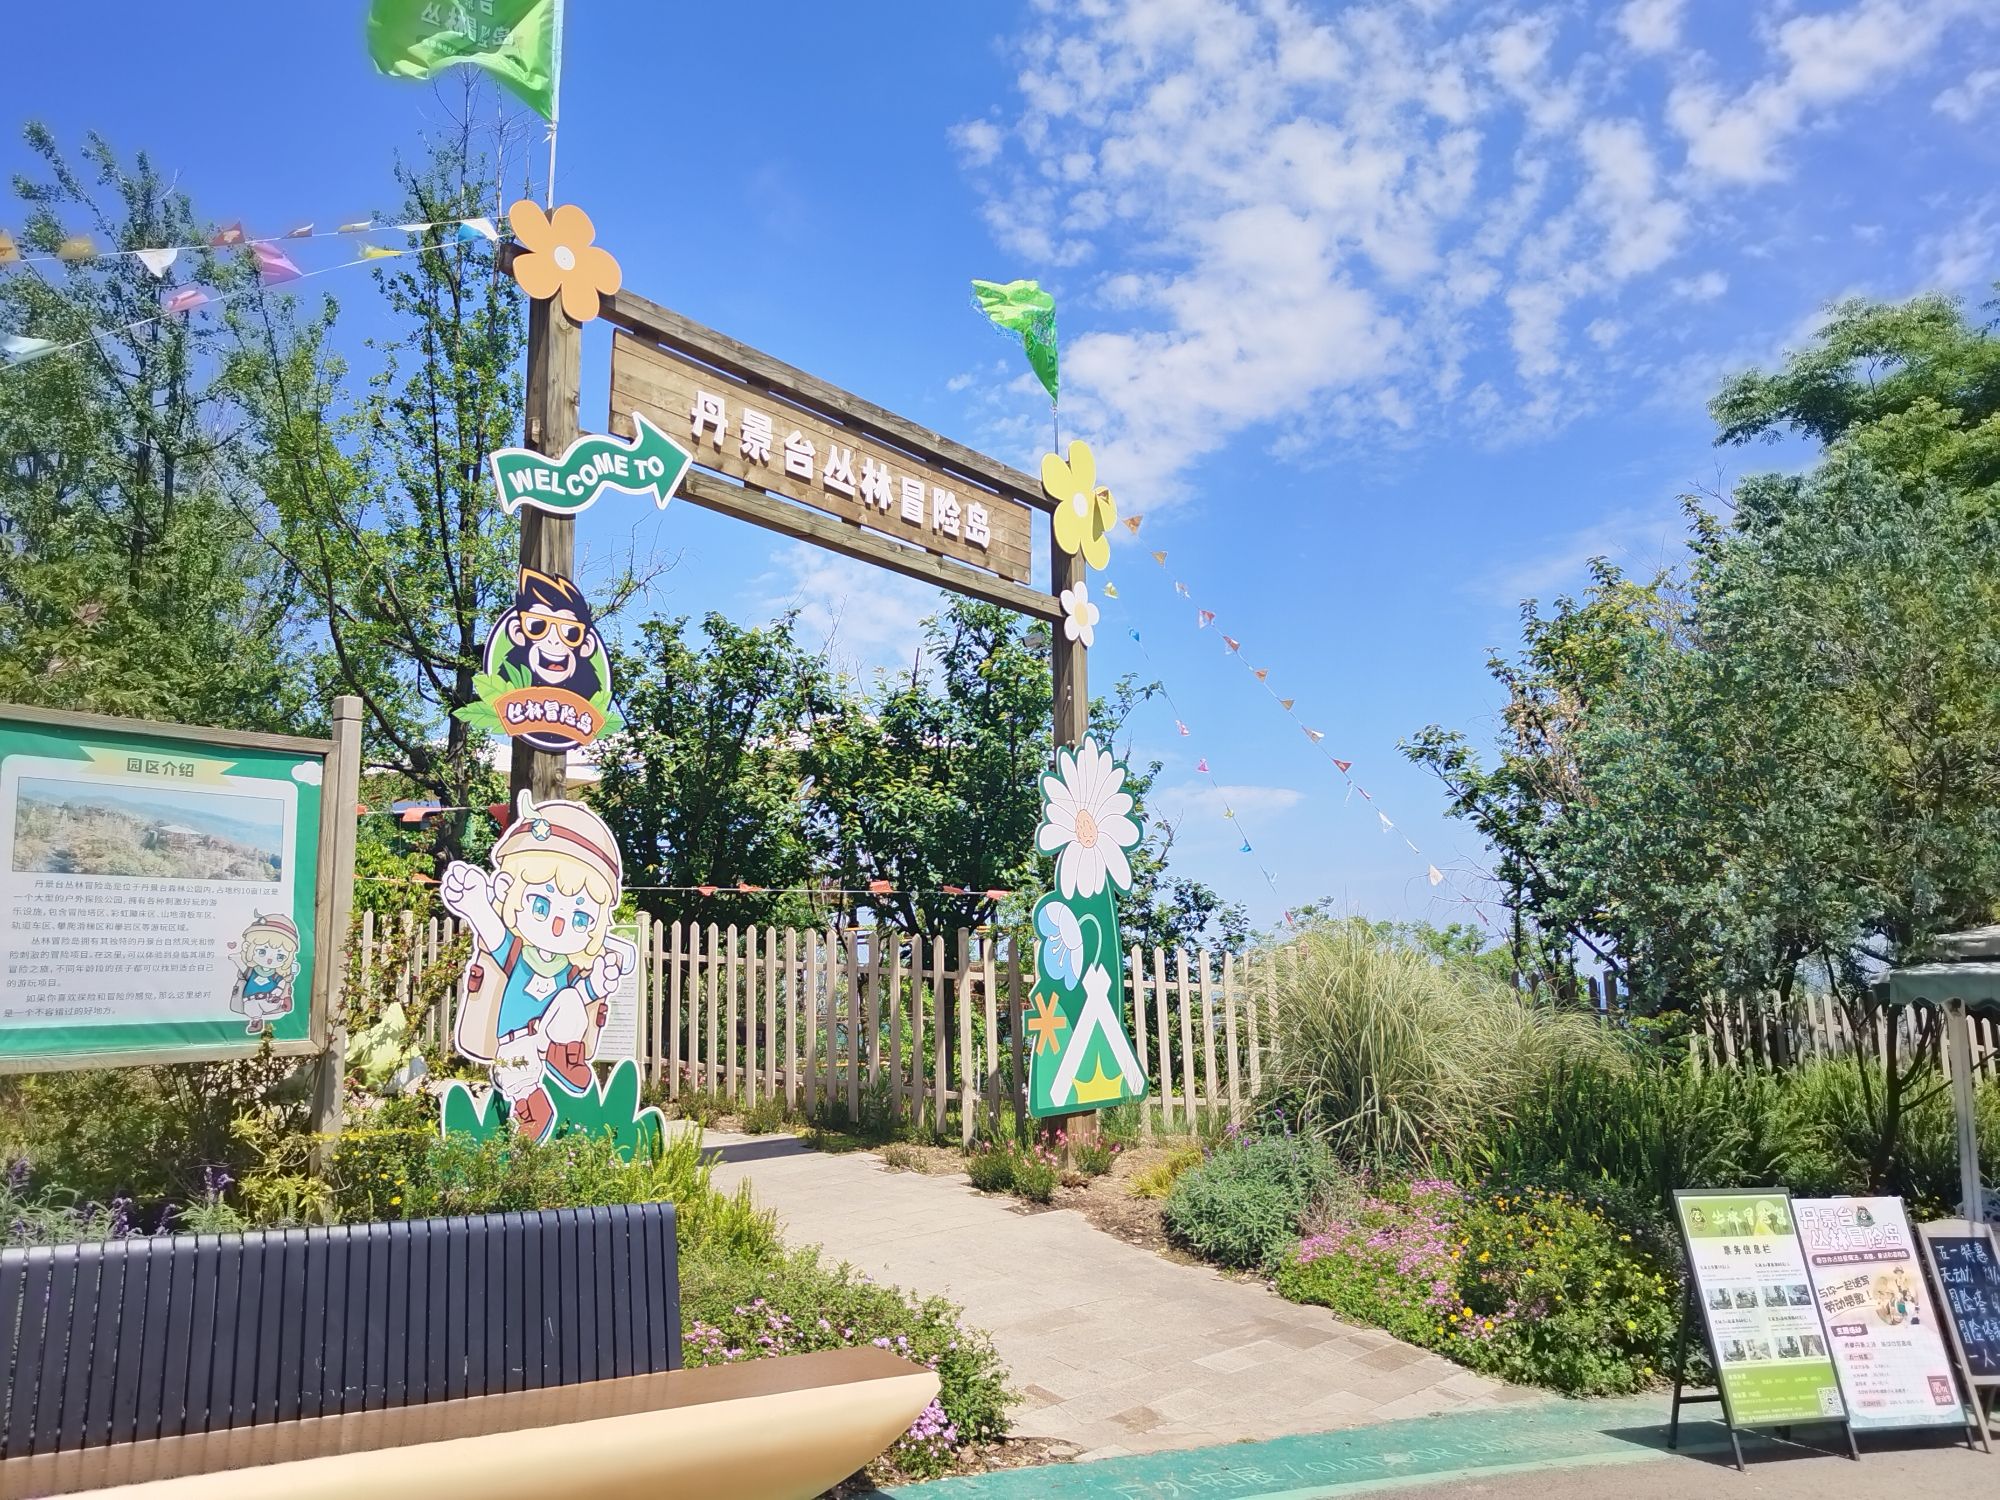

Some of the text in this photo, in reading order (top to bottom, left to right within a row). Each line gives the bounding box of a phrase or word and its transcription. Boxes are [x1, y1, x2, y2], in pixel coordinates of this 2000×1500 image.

[507, 451, 665, 496] WELCOME TO
[690, 389, 992, 551] 丹景台丛林冒险岛
[507, 700, 593, 736] 丛林冒险岛
[126, 757, 195, 778] 园区介绍
[1800, 1207, 1855, 1229] 丹景台
[1811, 1223, 1903, 1250] 丛林冒险岛
[1935, 1242, 1988, 1264] 五一特惠
